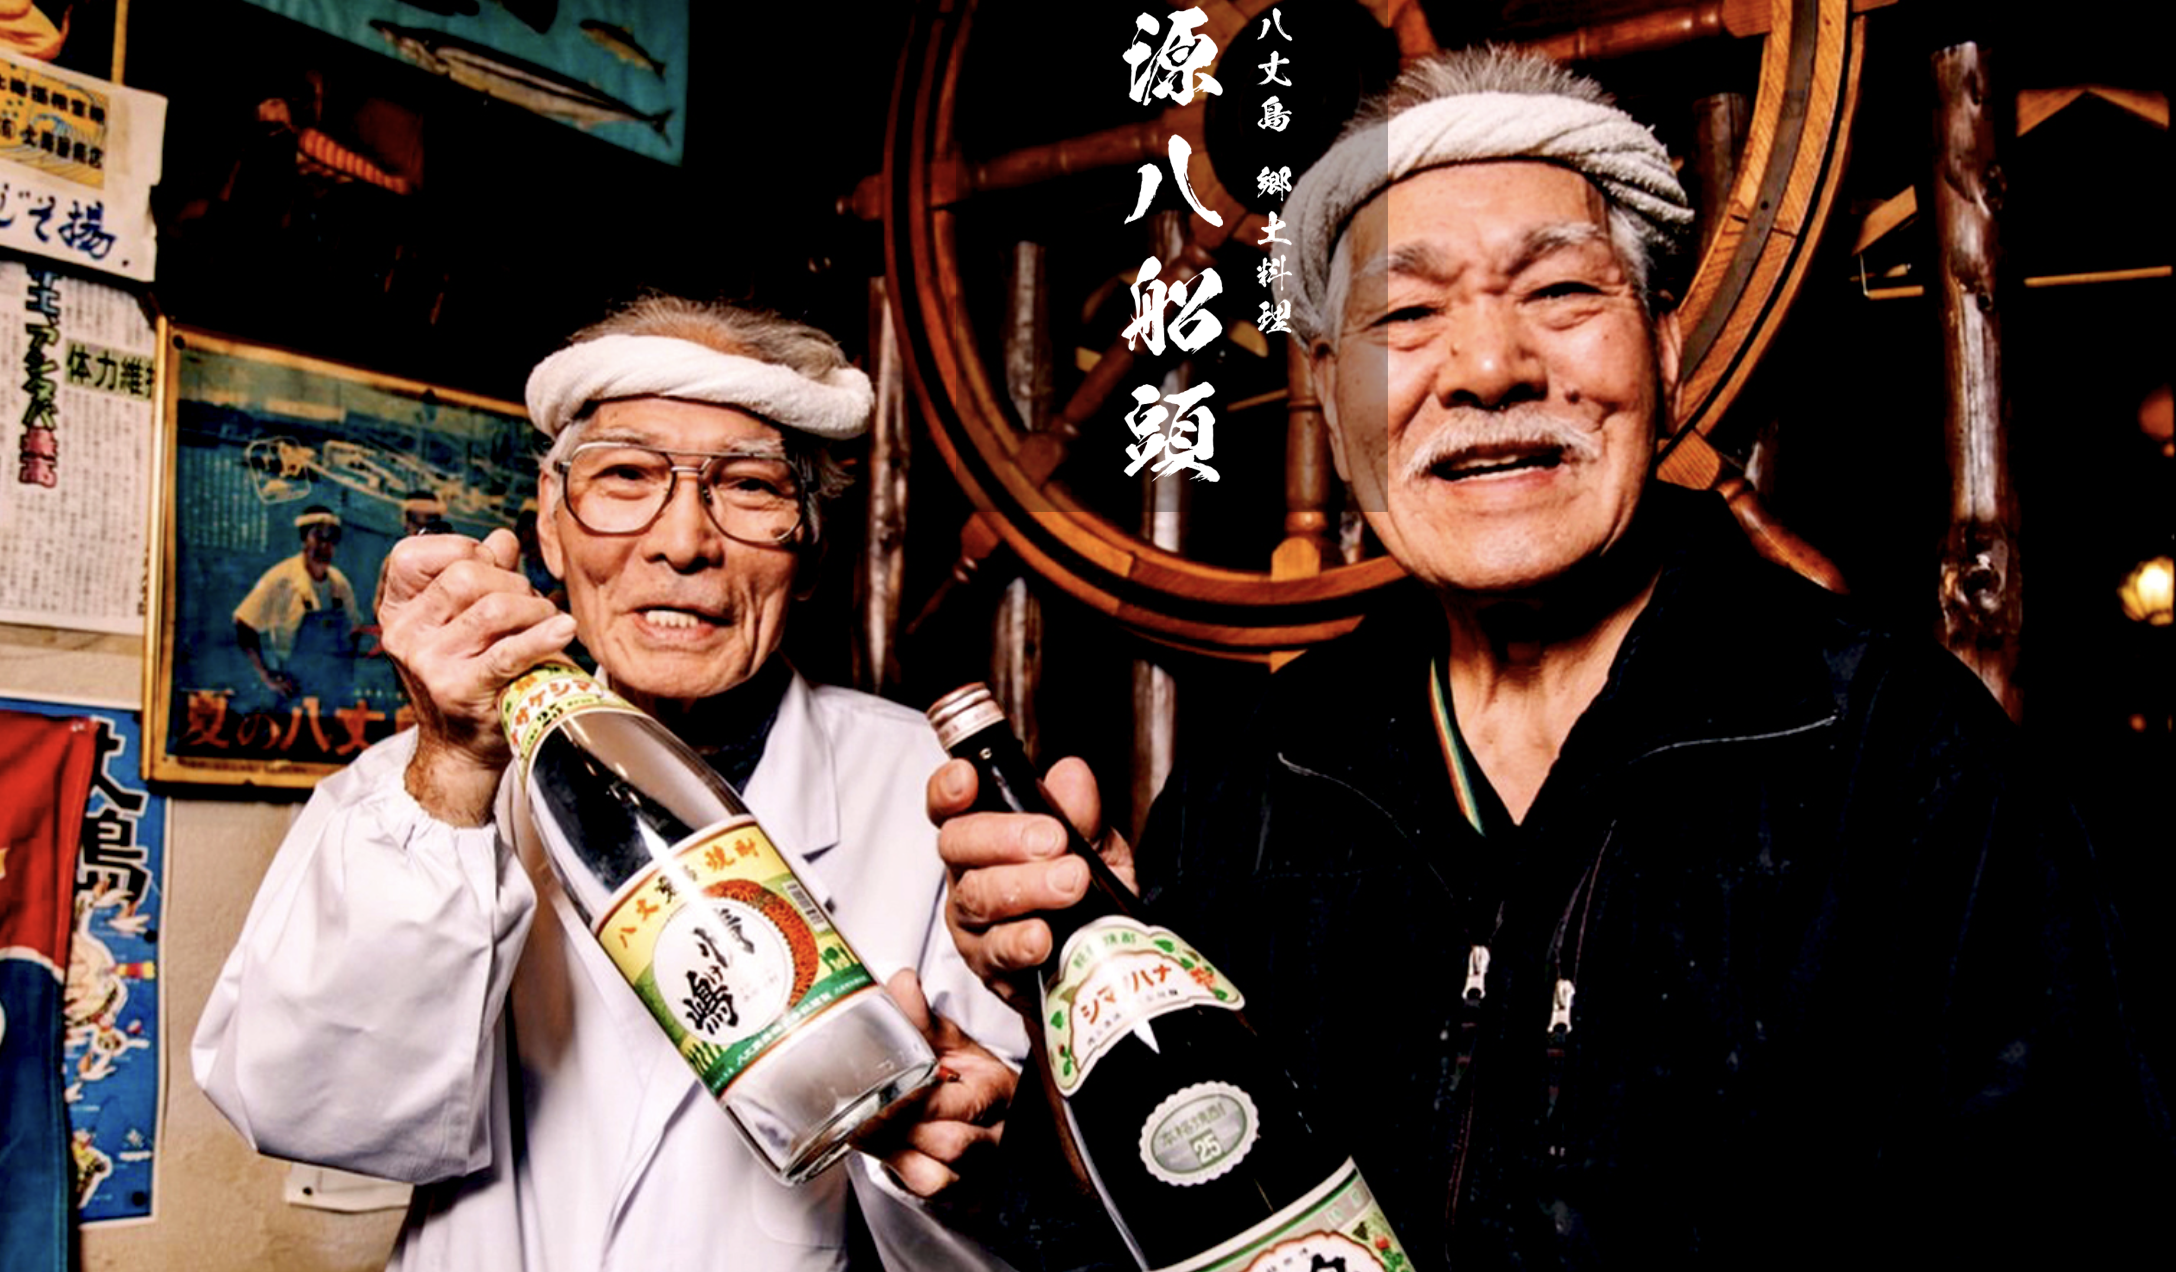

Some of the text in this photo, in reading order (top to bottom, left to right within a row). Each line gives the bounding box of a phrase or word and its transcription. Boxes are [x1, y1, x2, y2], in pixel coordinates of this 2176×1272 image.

[180, 689, 418, 756] 夏の八丈
[1080, 963, 1173, 1026] シマハナ
[1193, 1132, 1223, 1163] 25
